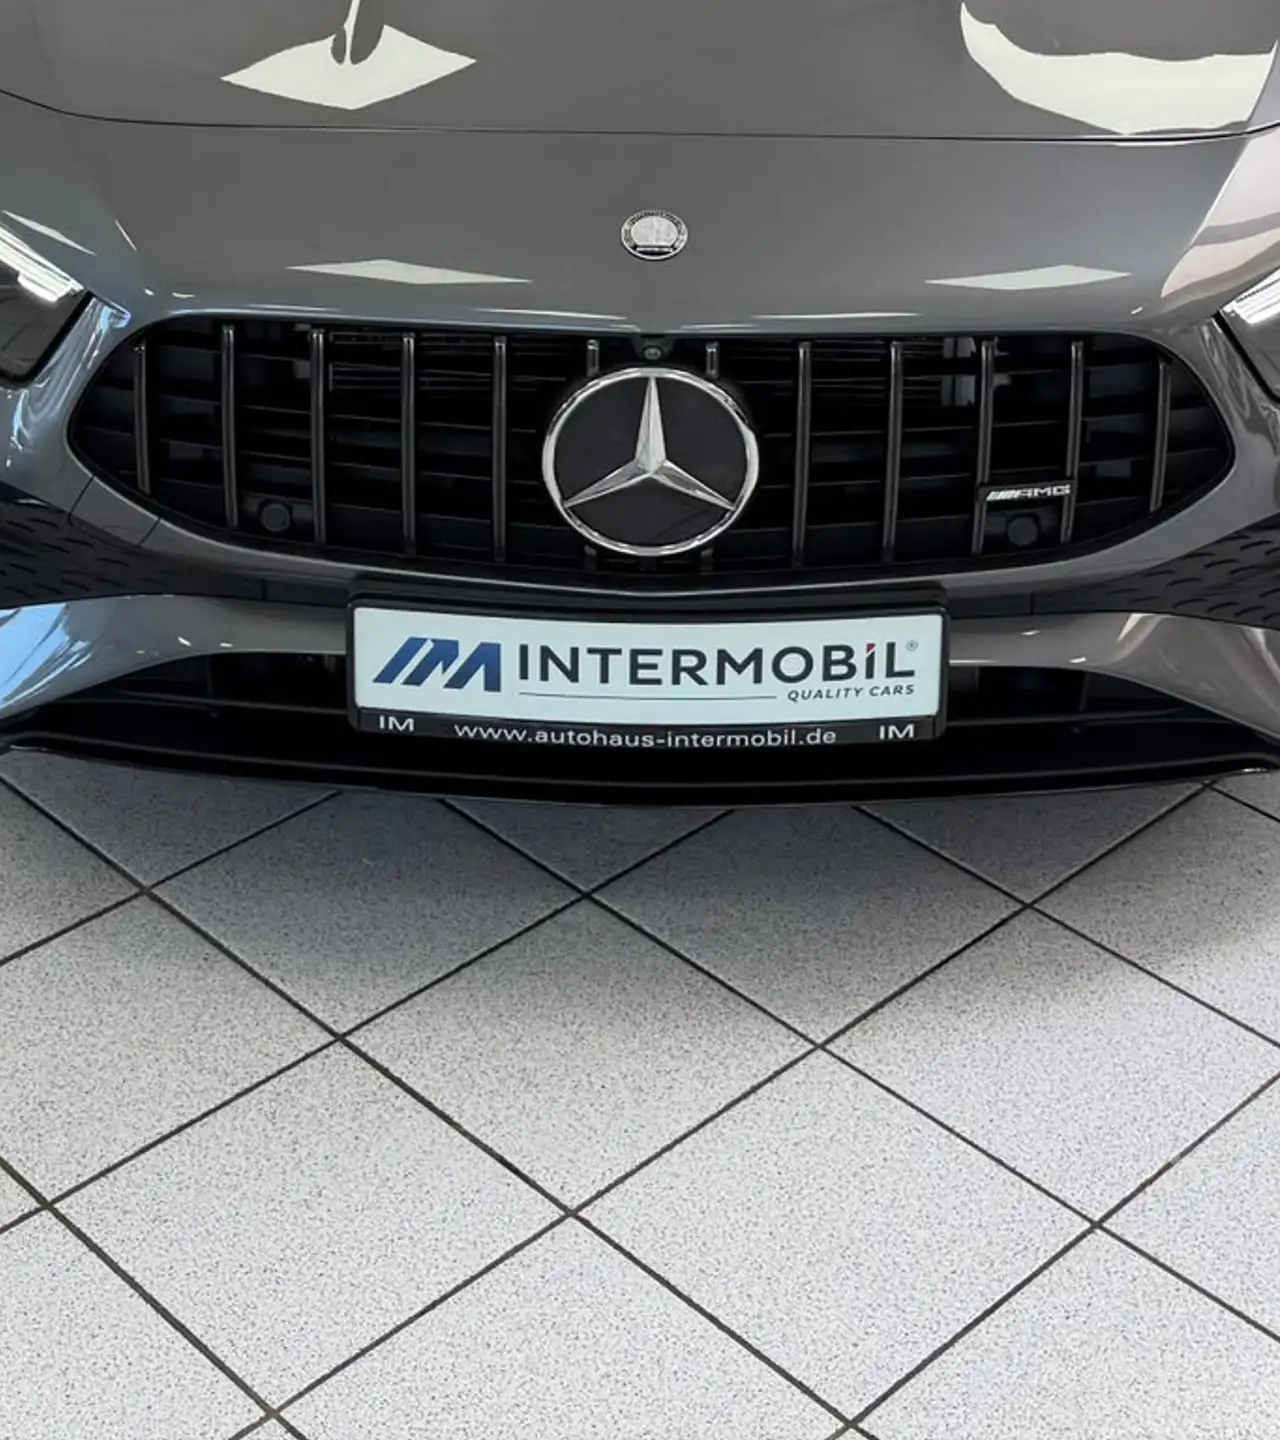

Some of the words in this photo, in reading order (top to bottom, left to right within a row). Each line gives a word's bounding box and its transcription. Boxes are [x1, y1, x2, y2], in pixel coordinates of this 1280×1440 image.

[787, 687, 864, 703] QUALITY
[869, 684, 916, 697] CARS
[378, 715, 415, 732] IM
[454, 724, 837, 749] www.autohaus-intermobil.de
[879, 724, 916, 740] IM
